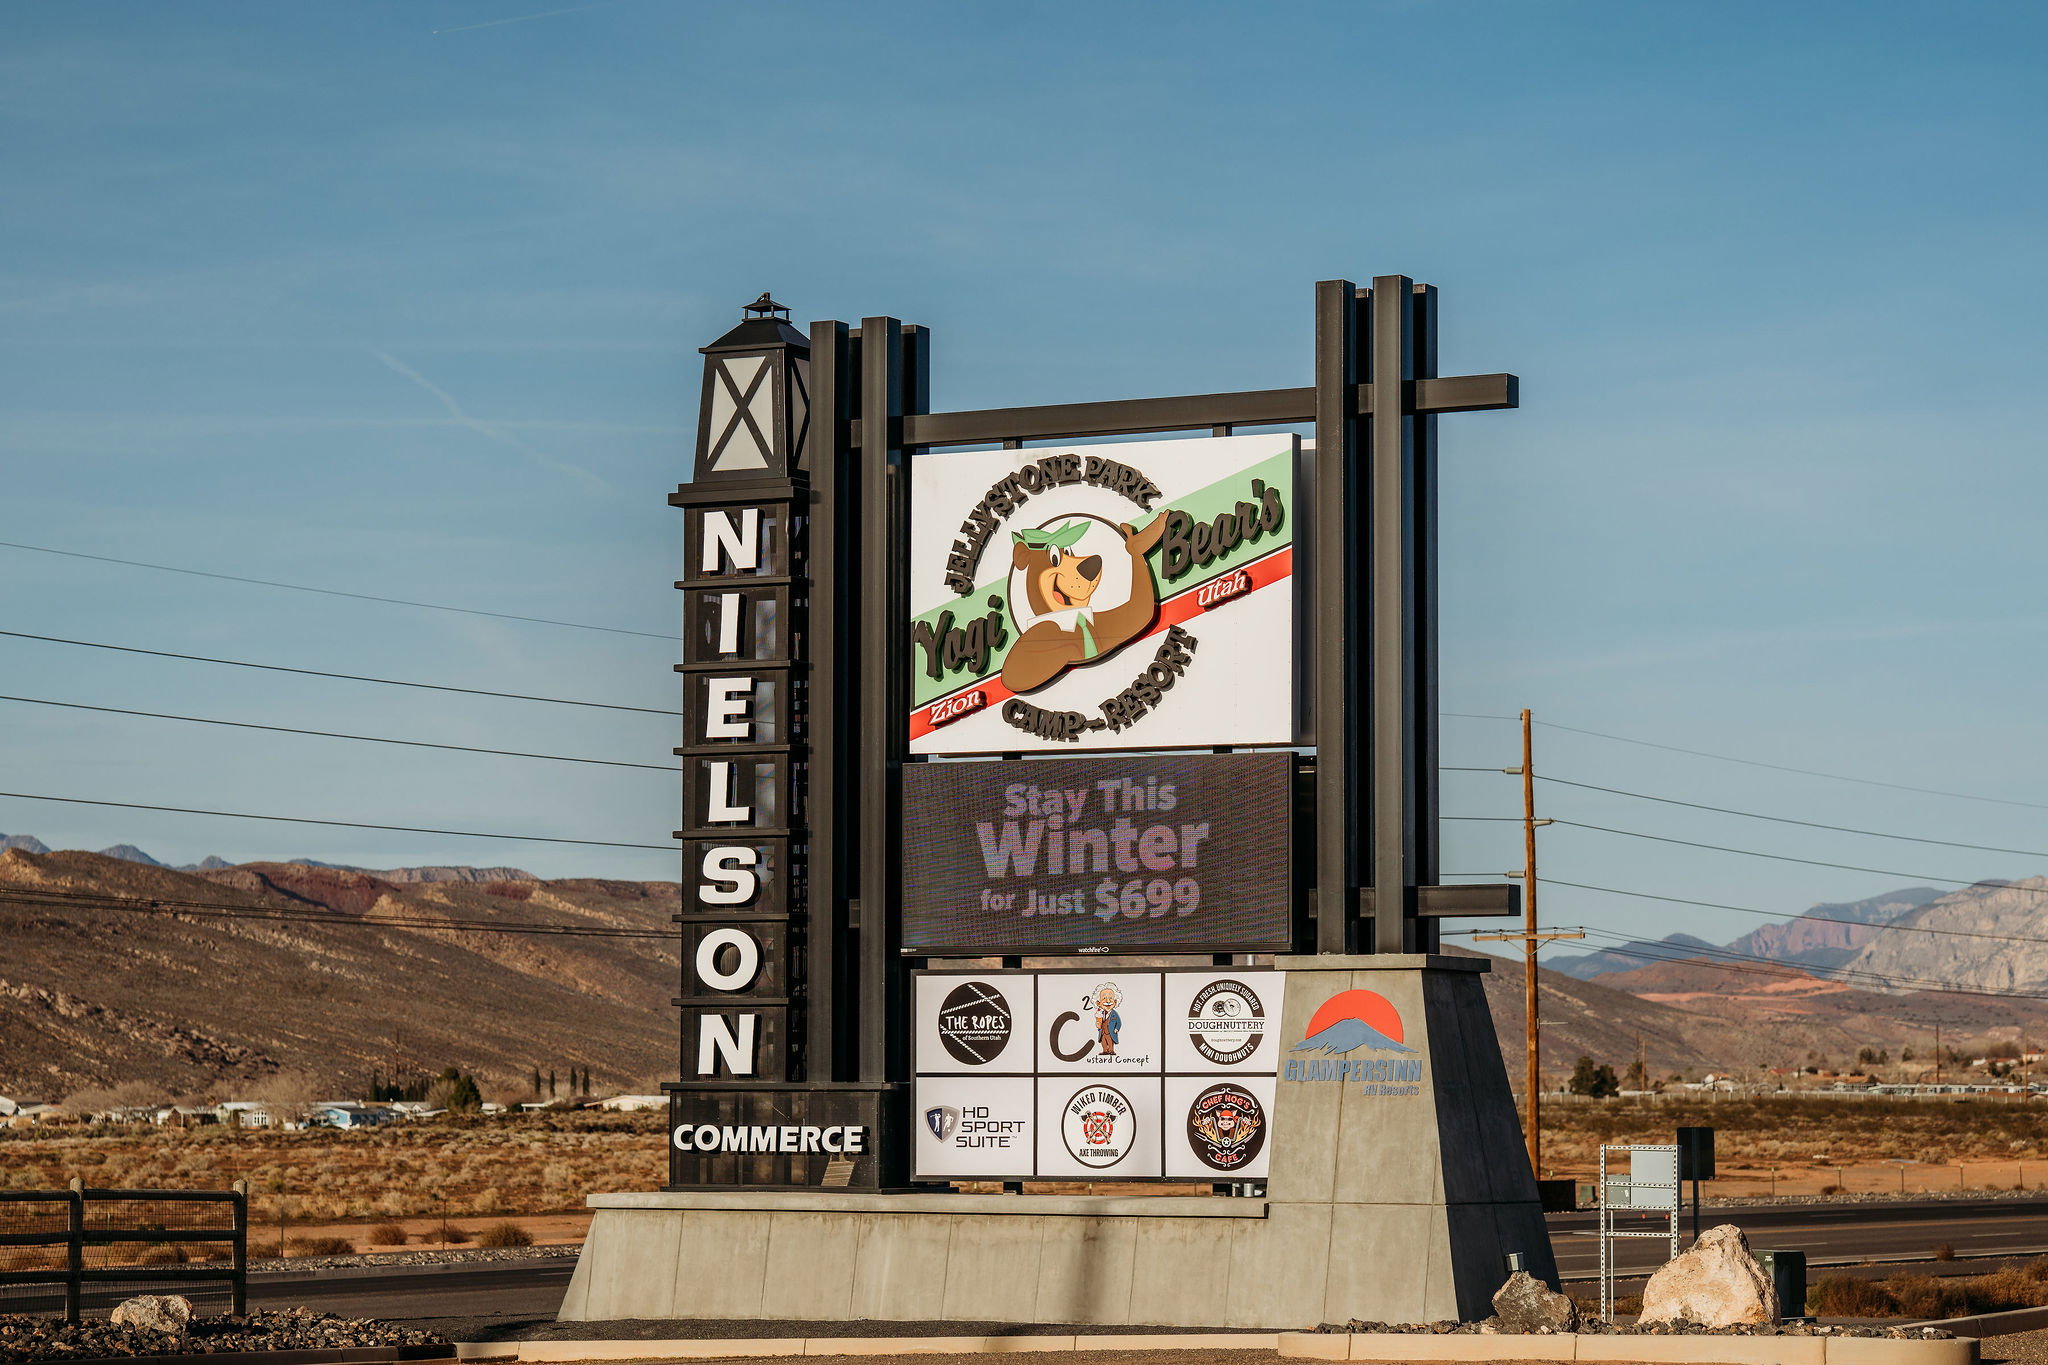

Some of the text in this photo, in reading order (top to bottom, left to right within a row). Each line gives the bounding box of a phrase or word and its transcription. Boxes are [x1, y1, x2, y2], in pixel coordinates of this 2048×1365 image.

[944, 453, 1163, 597] JELLYSTONE PARK
[913, 478, 1284, 681] Yogi Bear's
[929, 570, 1249, 724] Zion Utah
[696, 508, 762, 1075] NIELSON
[1004, 775, 1177, 823] Stay This
[976, 814, 1209, 878] Winter
[980, 877, 1200, 922] for Just $699
[945, 1015, 1005, 1030] THE ROPES
[1188, 1021, 1264, 1029] DOUGHNUTTERY
[1115, 1055, 1149, 1066] Concept
[1199, 1043, 1254, 1062] MINI DOUGHNUTS
[1284, 1059, 1422, 1082] GLAMPERSINN
[1379, 1084, 1419, 1096] Resorts
[1071, 1091, 1126, 1115] WIKED TIMBER
[1202, 1094, 1250, 1109] CHEF HOG'S
[962, 1106, 989, 1119] HD
[961, 1121, 1025, 1133] SPORT
[673, 1124, 863, 1152] COMMERCE
[1079, 1149, 1118, 1157] AXE THROWING
[1215, 1153, 1238, 1163] CAFE
